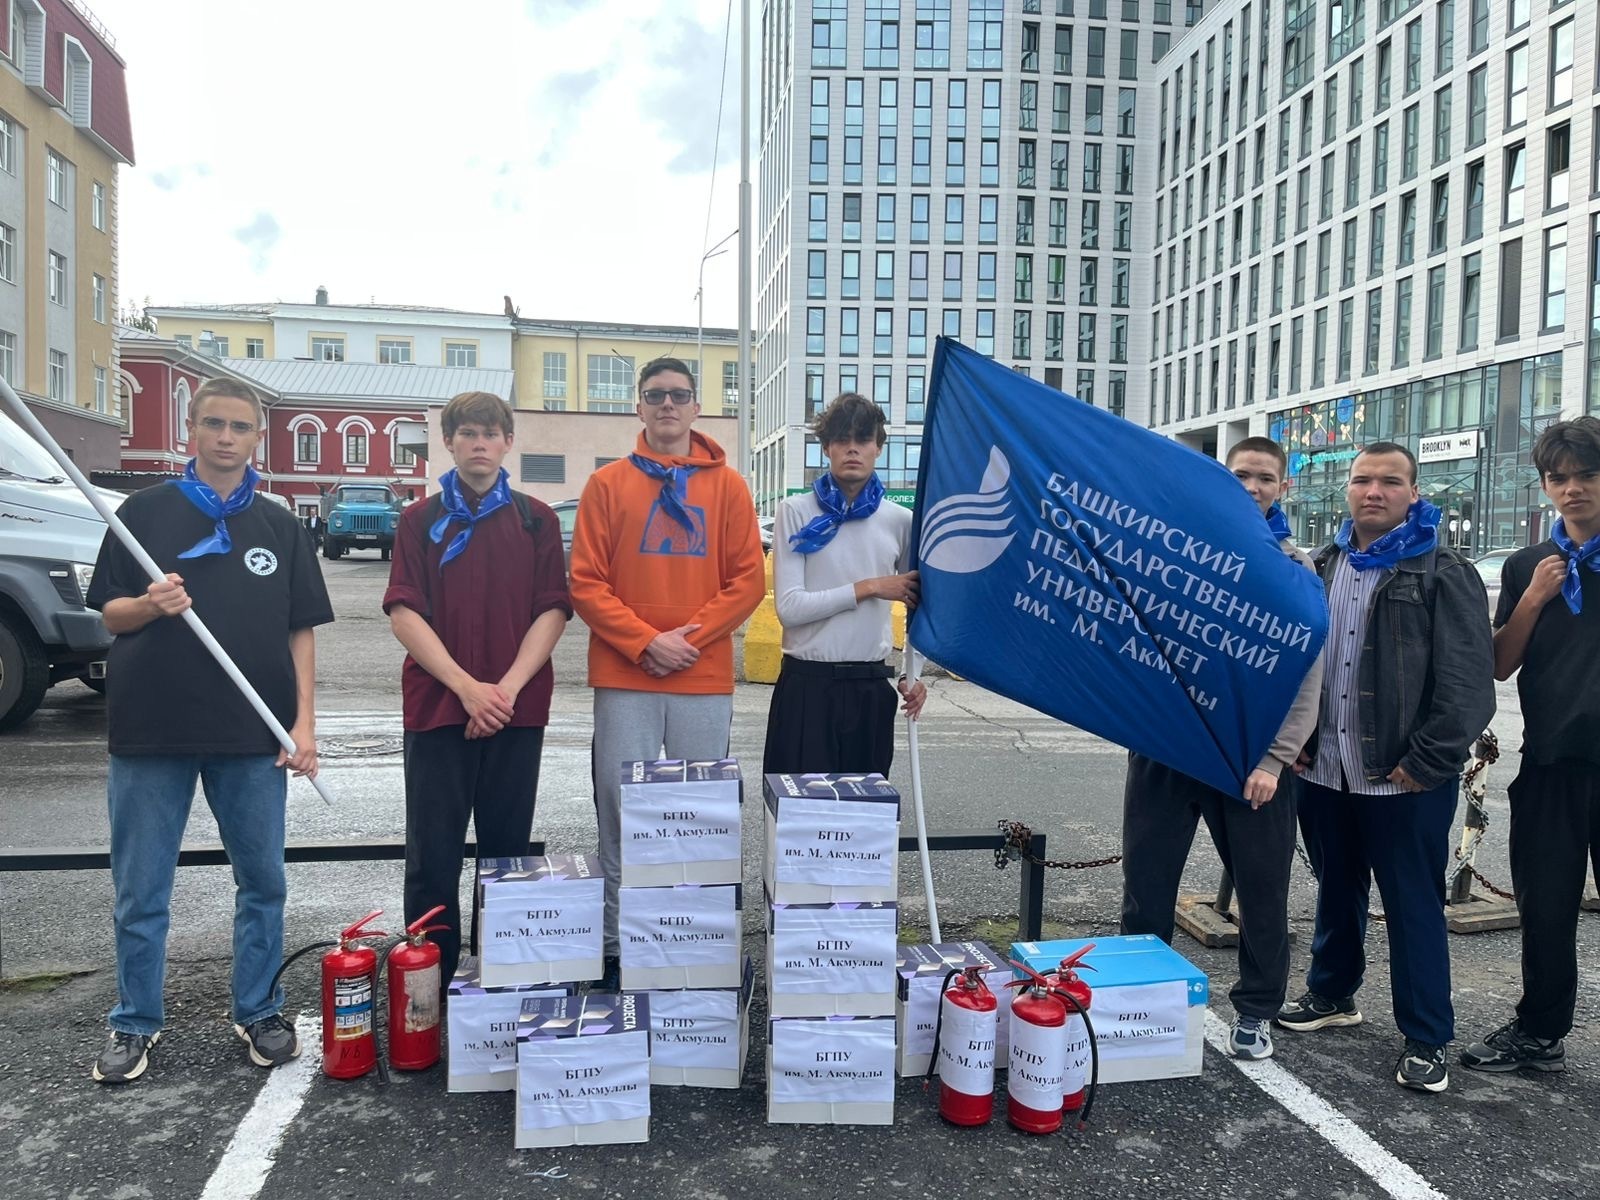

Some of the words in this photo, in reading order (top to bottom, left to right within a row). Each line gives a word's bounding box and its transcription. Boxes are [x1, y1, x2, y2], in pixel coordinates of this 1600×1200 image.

[1422, 440, 1451, 453] BROOKLYN
[887, 495, 915, 503] БОЛЕЗ
[1046, 471, 1246, 583] БАШКИРСКИЙ
[1040, 498, 1312, 653] ГОСУДАРСТВЕННЫЙ
[1026, 560, 1208, 675] УНИВЕРСТЕТ
[1013, 591, 1056, 625] им.
[1071, 613, 1104, 645] М.
[1118, 635, 1218, 711] Акмлы
[663, 811, 698, 821] БГПУ
[633, 832, 652, 840] им.
[656, 828, 671, 838] М.
[674, 828, 728, 839] Акмуллы
[818, 830, 854, 841] БГПУ
[785, 848, 804, 857] им.
[808, 848, 823, 858] М.
[827, 850, 881, 861] Акмуллы
[527, 910, 562, 920] БГПУ
[659, 916, 694, 926] БГПУ
[518, 927, 533, 937] М.
[536, 927, 591, 938] Акмуллы
[630, 935, 649, 943] им.
[652, 933, 667, 942] М.
[670, 933, 724, 943] Акмуллы
[817, 940, 853, 950] БГПУ
[808, 958, 824, 967] М.
[827, 958, 883, 969] Акмуллы
[623, 995, 636, 1031] PROJECTA
[1118, 1012, 1150, 1021] БГПУ
[490, 1021, 519, 1032] БГП
[663, 1018, 696, 1028] БГПУ
[1112, 1030, 1126, 1039] М.
[1129, 1026, 1176, 1037] Акмуллы
[482, 1040, 498, 1049] М.
[656, 1033, 670, 1042] М.
[674, 1034, 726, 1045] Акмуллы
[816, 1052, 852, 1062] БГПУ
[1013, 1045, 1046, 1066] БГПУ
[957, 1055, 971, 1068] М.
[565, 1066, 604, 1080] БГПУ
[784, 1070, 804, 1078] им.
[807, 1070, 823, 1078] М.
[826, 1070, 883, 1080] Акмуллы
[533, 1093, 554, 1101] им.
[558, 1089, 574, 1098] М.
[578, 1084, 637, 1097] Акмуллы
